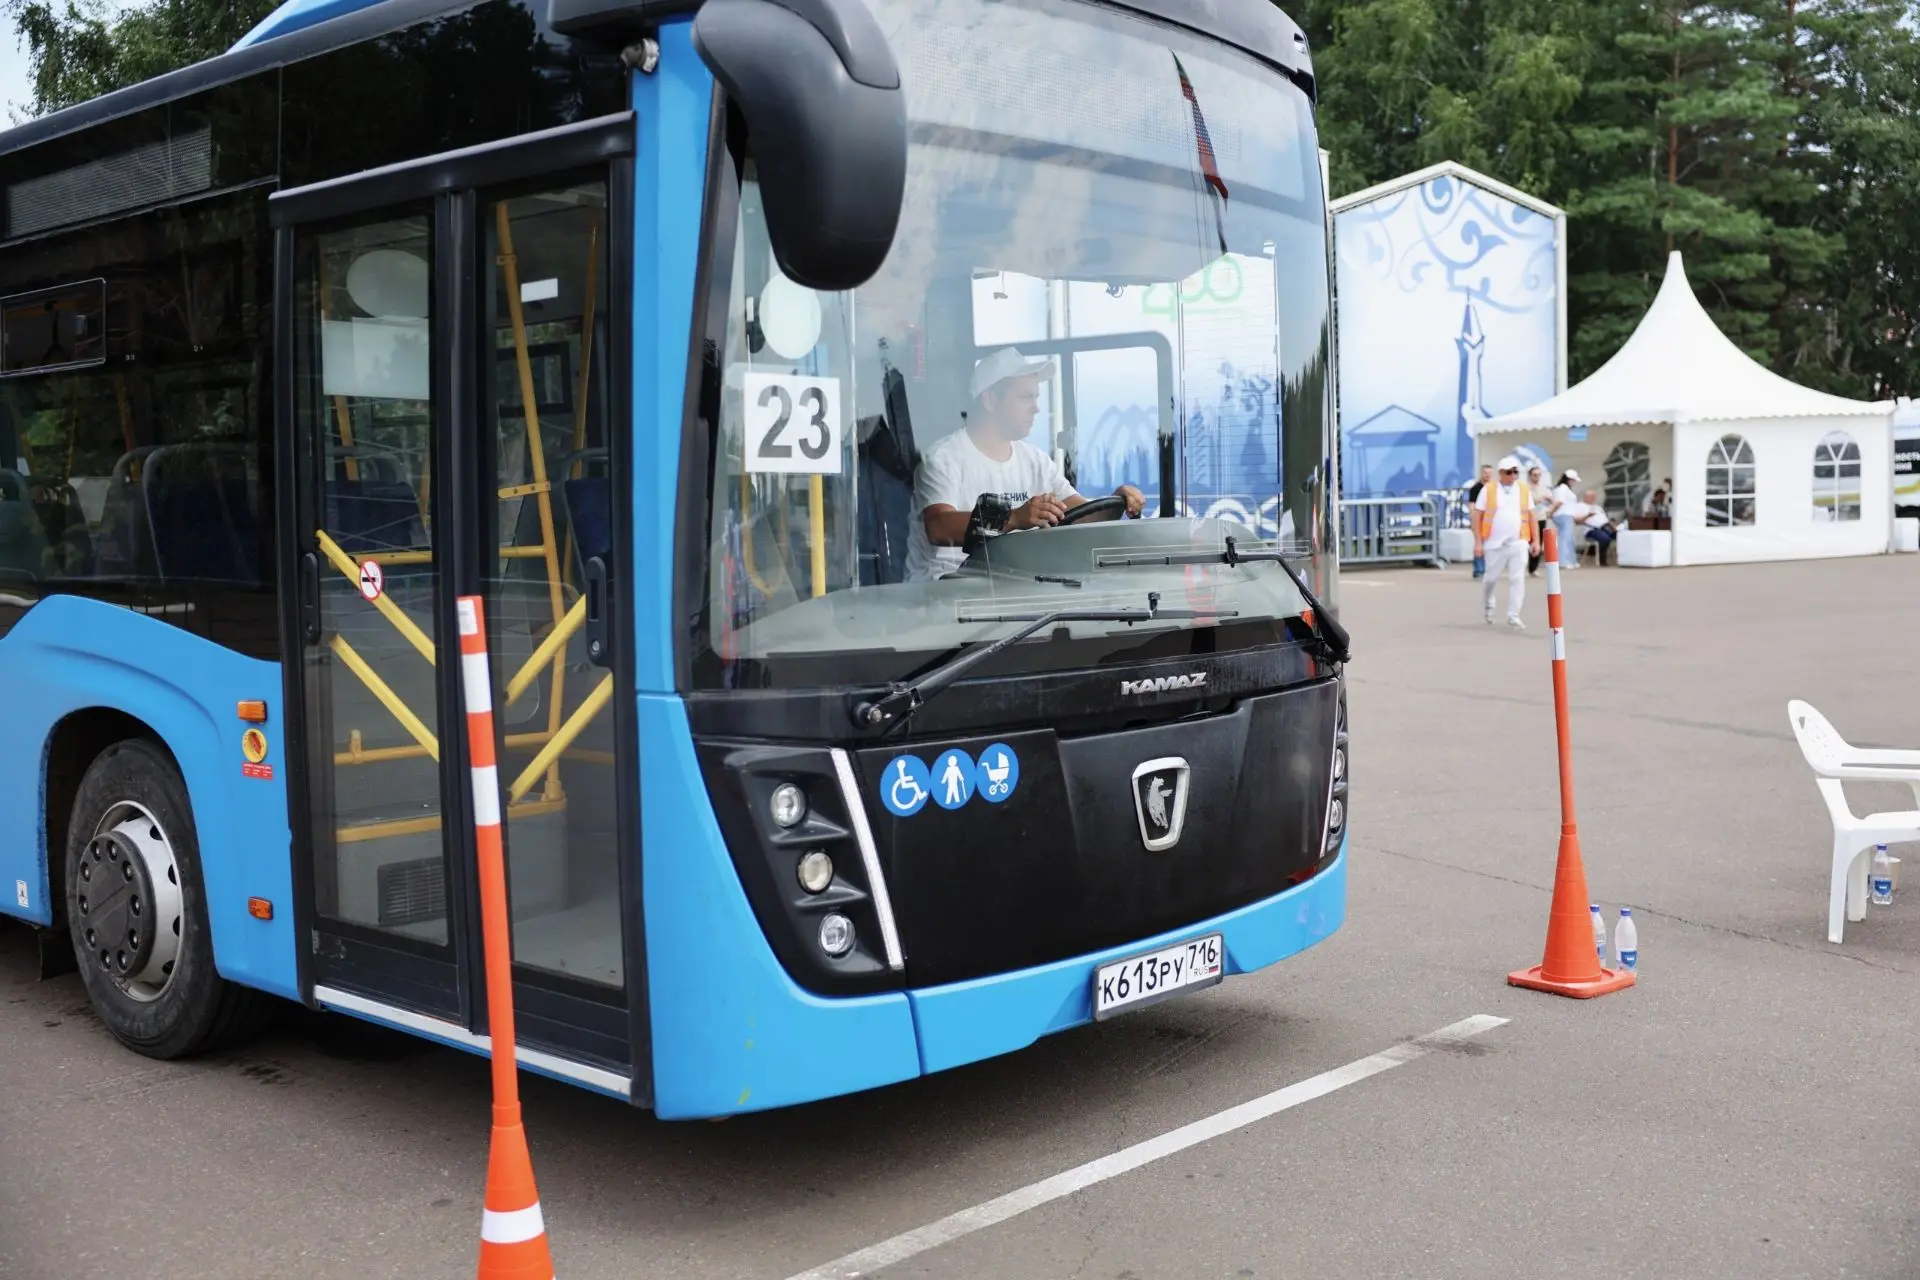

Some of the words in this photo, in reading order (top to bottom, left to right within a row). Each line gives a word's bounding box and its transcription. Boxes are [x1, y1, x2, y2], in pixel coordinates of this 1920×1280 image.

[757, 384, 831, 460] 23
[1120, 671, 1207, 696] KAMAZ
[1103, 956, 1184, 1004] К613РУ
[1188, 939, 1216, 969] 716
[1193, 965, 1209, 977] RUS
